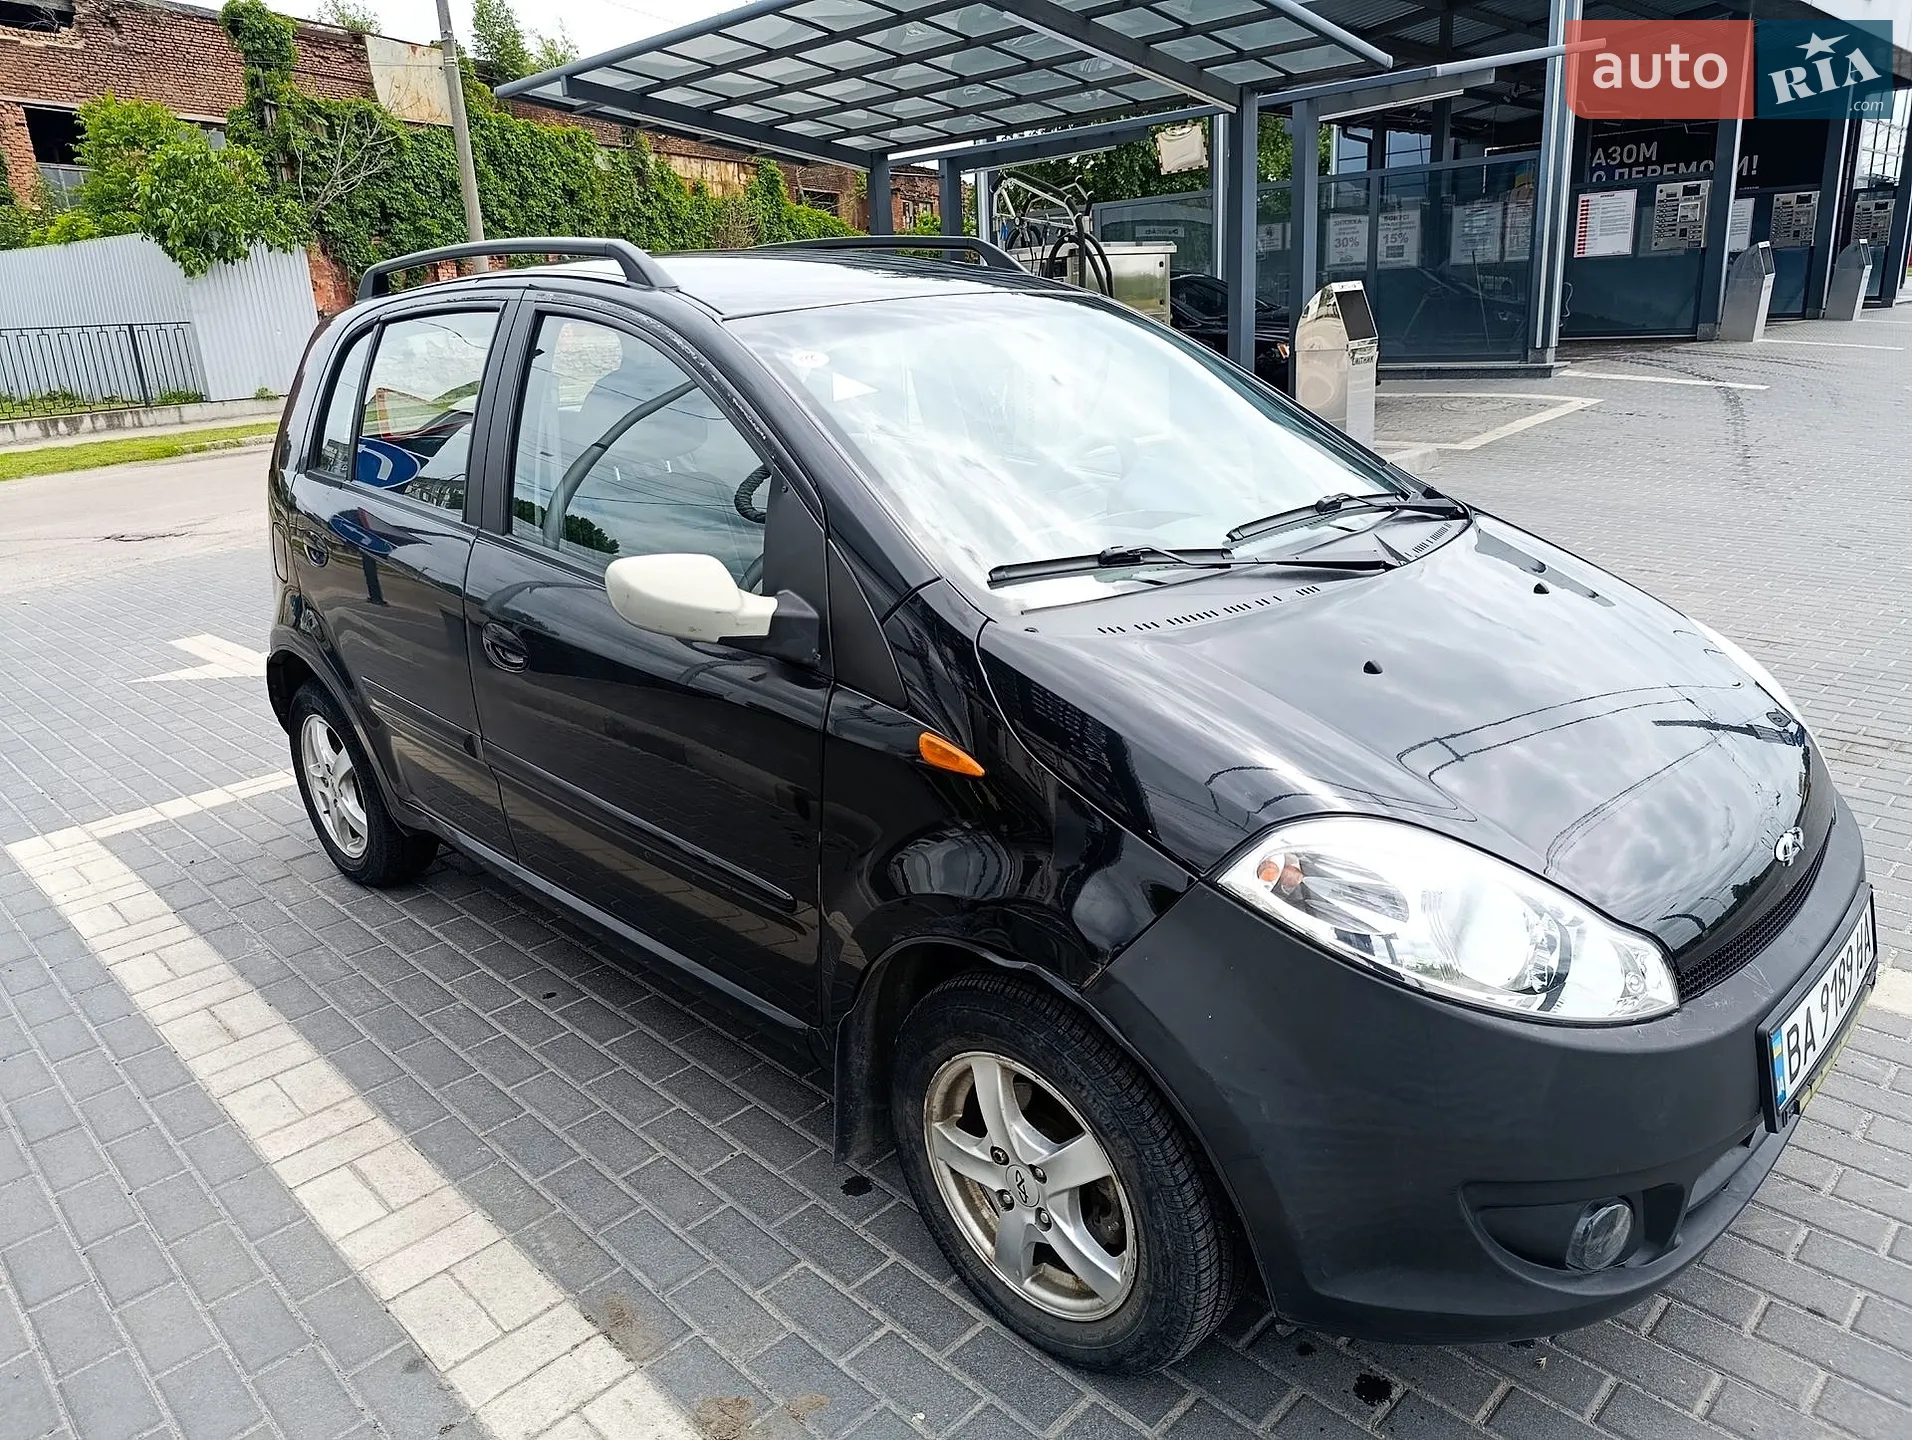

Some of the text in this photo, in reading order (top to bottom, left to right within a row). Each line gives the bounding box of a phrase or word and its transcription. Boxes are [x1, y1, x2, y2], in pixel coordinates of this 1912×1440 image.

[1592, 141, 1658, 167] АЗОМ
[1334, 236, 1360, 248] 30%
[1383, 232, 1409, 244] 15%
[1786, 912, 1871, 1084] BA 9189 HA
